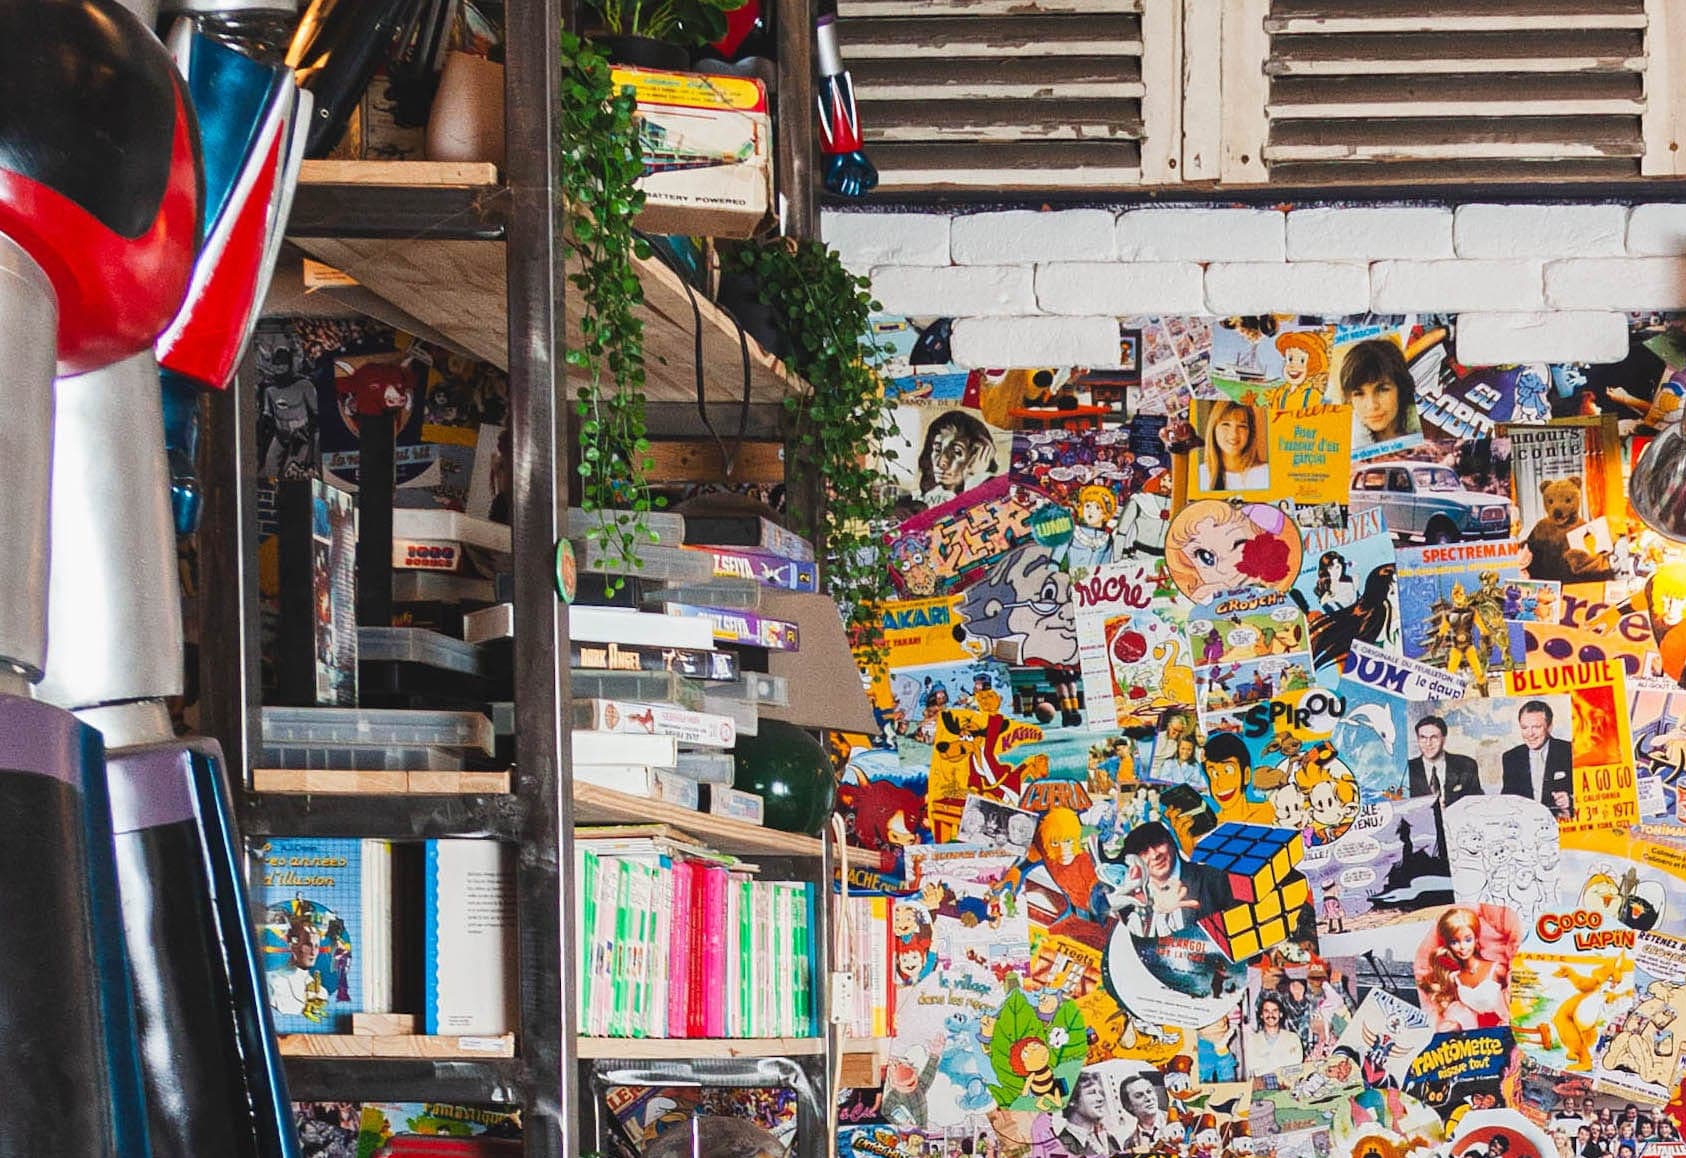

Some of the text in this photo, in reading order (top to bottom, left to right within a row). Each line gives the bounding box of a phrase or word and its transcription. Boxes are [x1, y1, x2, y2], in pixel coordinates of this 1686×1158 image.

[694, 195, 747, 206] POWERED
[1035, 517, 1072, 538] LUNDI
[1422, 543, 1520, 564] SPECTREMAN
[1073, 567, 1152, 609] récré
[878, 605, 950, 630] AKARI
[1512, 660, 1615, 692] BLONDIE
[1244, 692, 1347, 738] SPIROU
[1581, 771, 1590, 793] A
[1595, 768, 1611, 791] GO
[1616, 766, 1633, 790] GO
[1612, 801, 1635, 818] 1977
[846, 868, 881, 892] ACHE
[1535, 909, 1604, 944] COCO
